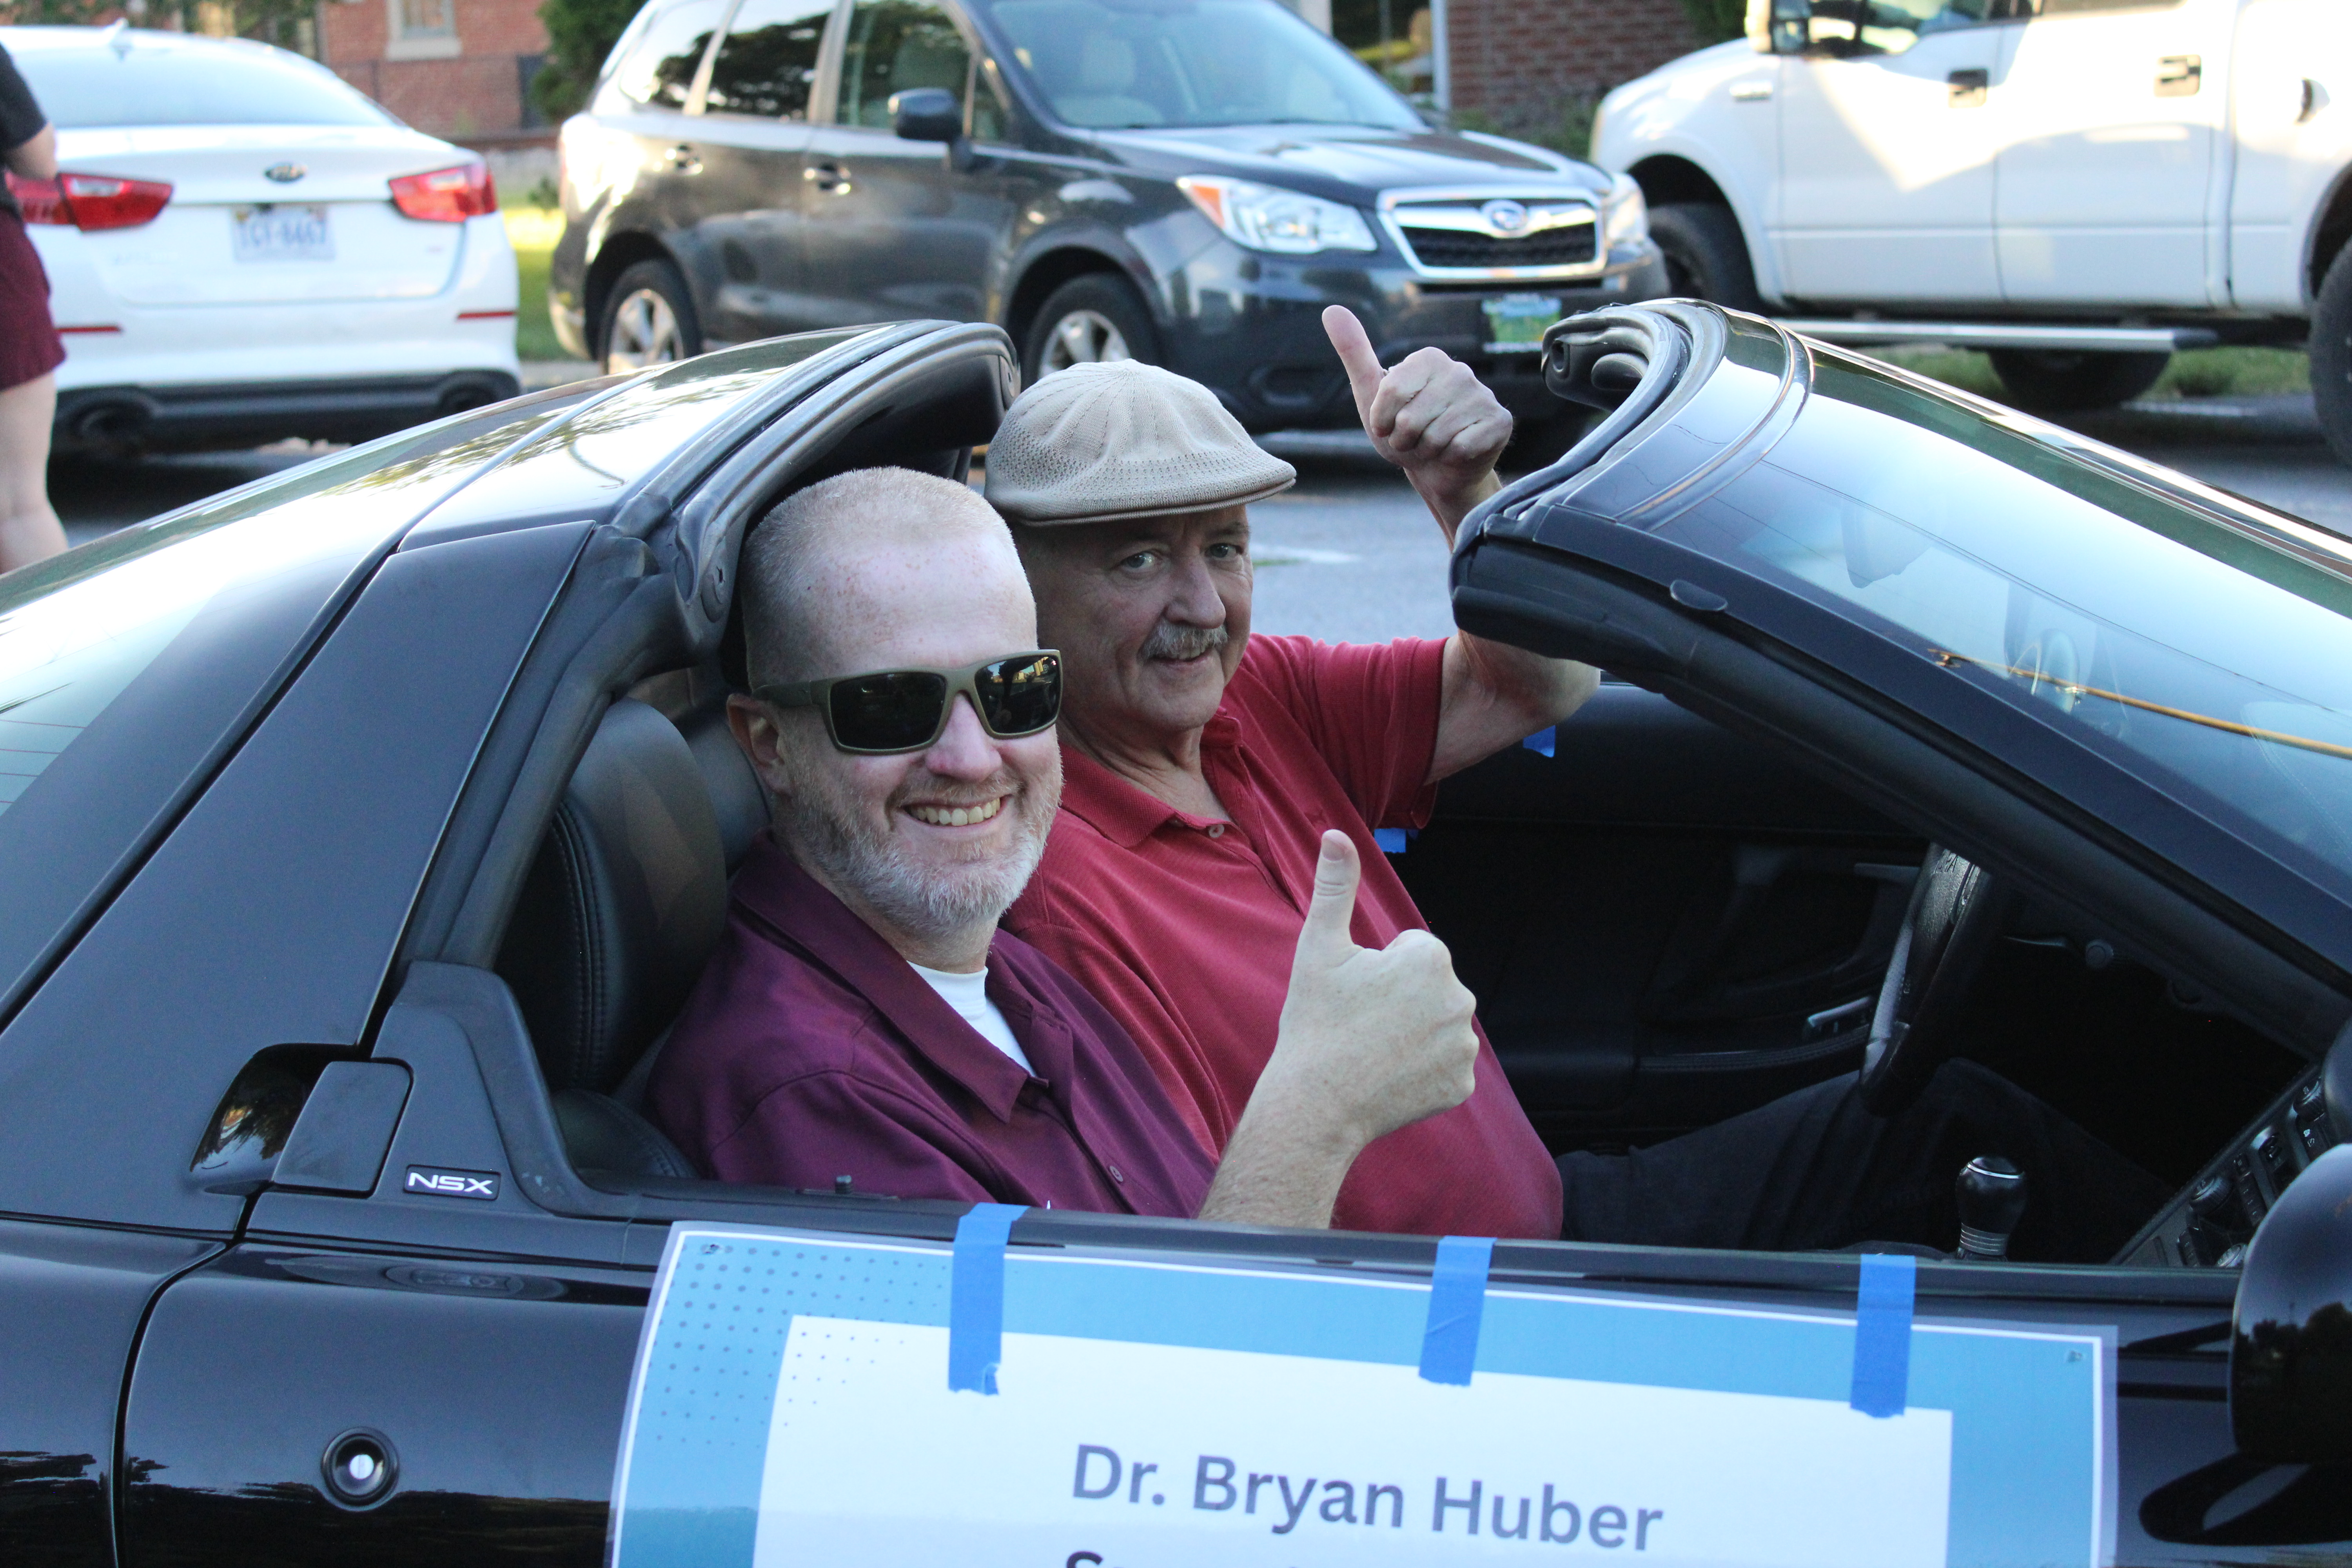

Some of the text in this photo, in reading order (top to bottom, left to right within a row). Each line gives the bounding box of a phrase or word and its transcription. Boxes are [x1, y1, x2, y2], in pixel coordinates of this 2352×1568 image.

[407, 1172, 493, 1194] NSX
[1073, 1444, 1664, 1551] Dr. Bryan Huber
